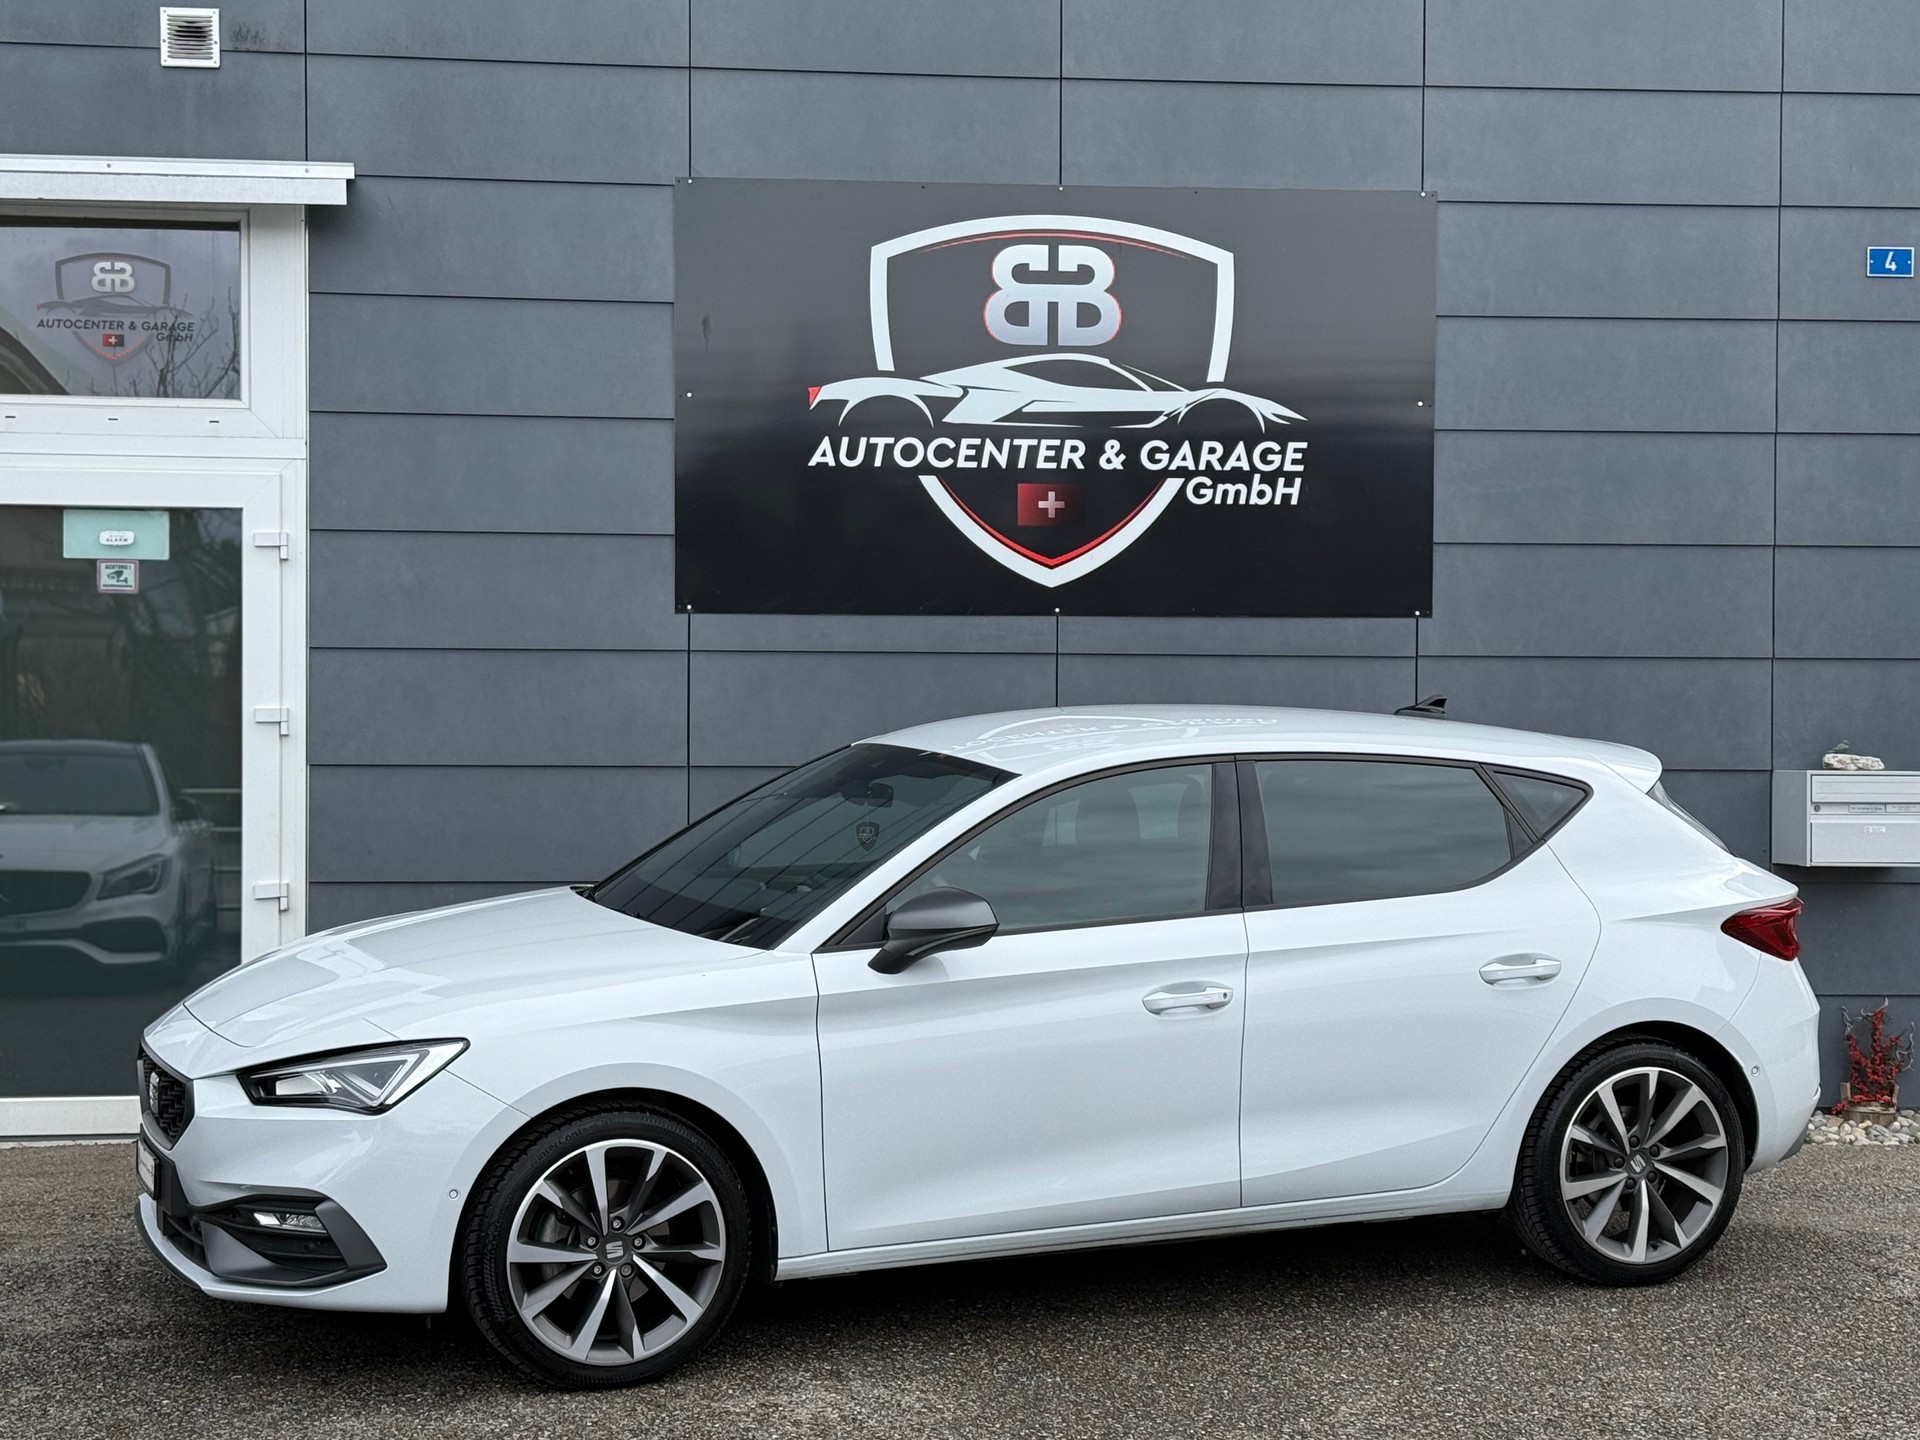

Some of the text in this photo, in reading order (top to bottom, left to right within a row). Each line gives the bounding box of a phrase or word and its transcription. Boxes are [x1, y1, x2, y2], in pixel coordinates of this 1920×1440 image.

[1885, 251, 1897, 272] 4
[37, 318, 195, 333] AUTOCENTER & GARAGE
[156, 332, 193, 343] GmbH
[808, 435, 1308, 472] AUTOCENTER & GARAGE
[1186, 473, 1302, 506] GmbH
